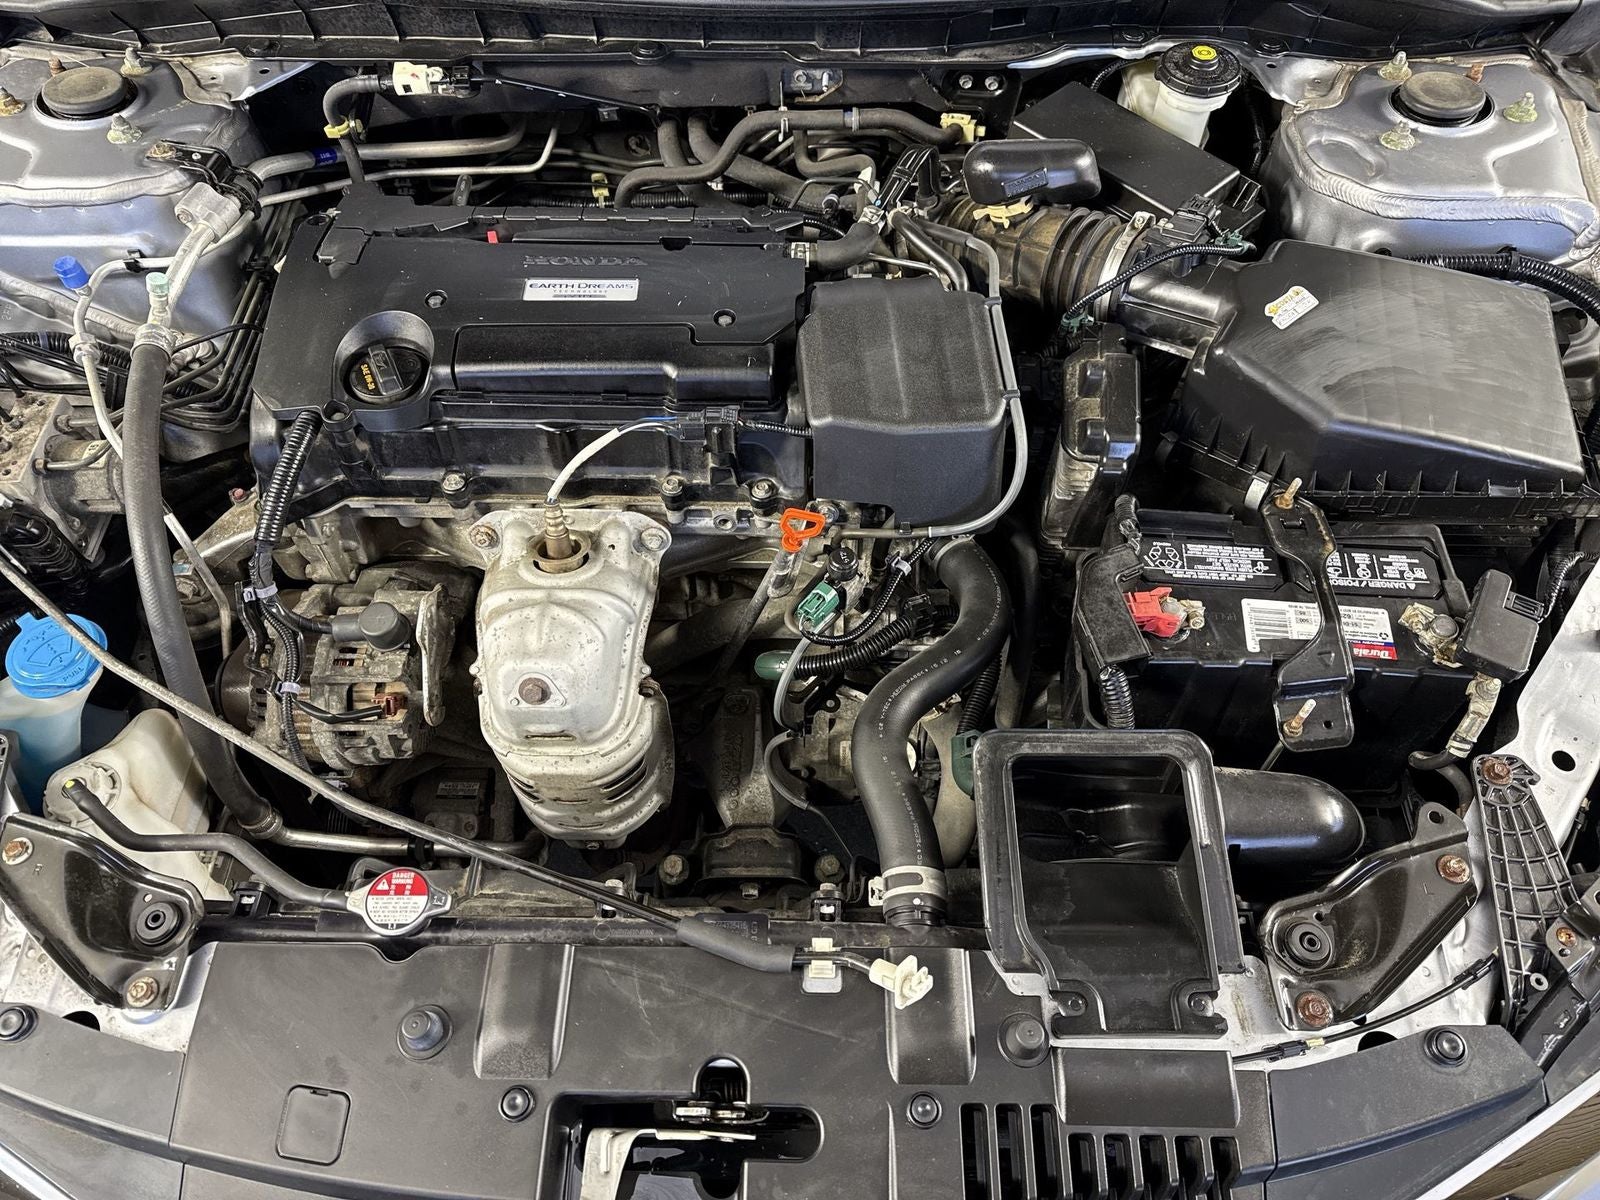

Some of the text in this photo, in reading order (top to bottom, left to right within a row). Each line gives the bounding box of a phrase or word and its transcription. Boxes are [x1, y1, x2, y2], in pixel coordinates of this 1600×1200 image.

[523, 255, 648, 266] HONDA
[1368, 580, 1407, 590] DANGER
[1352, 647, 1393, 660] Durala
